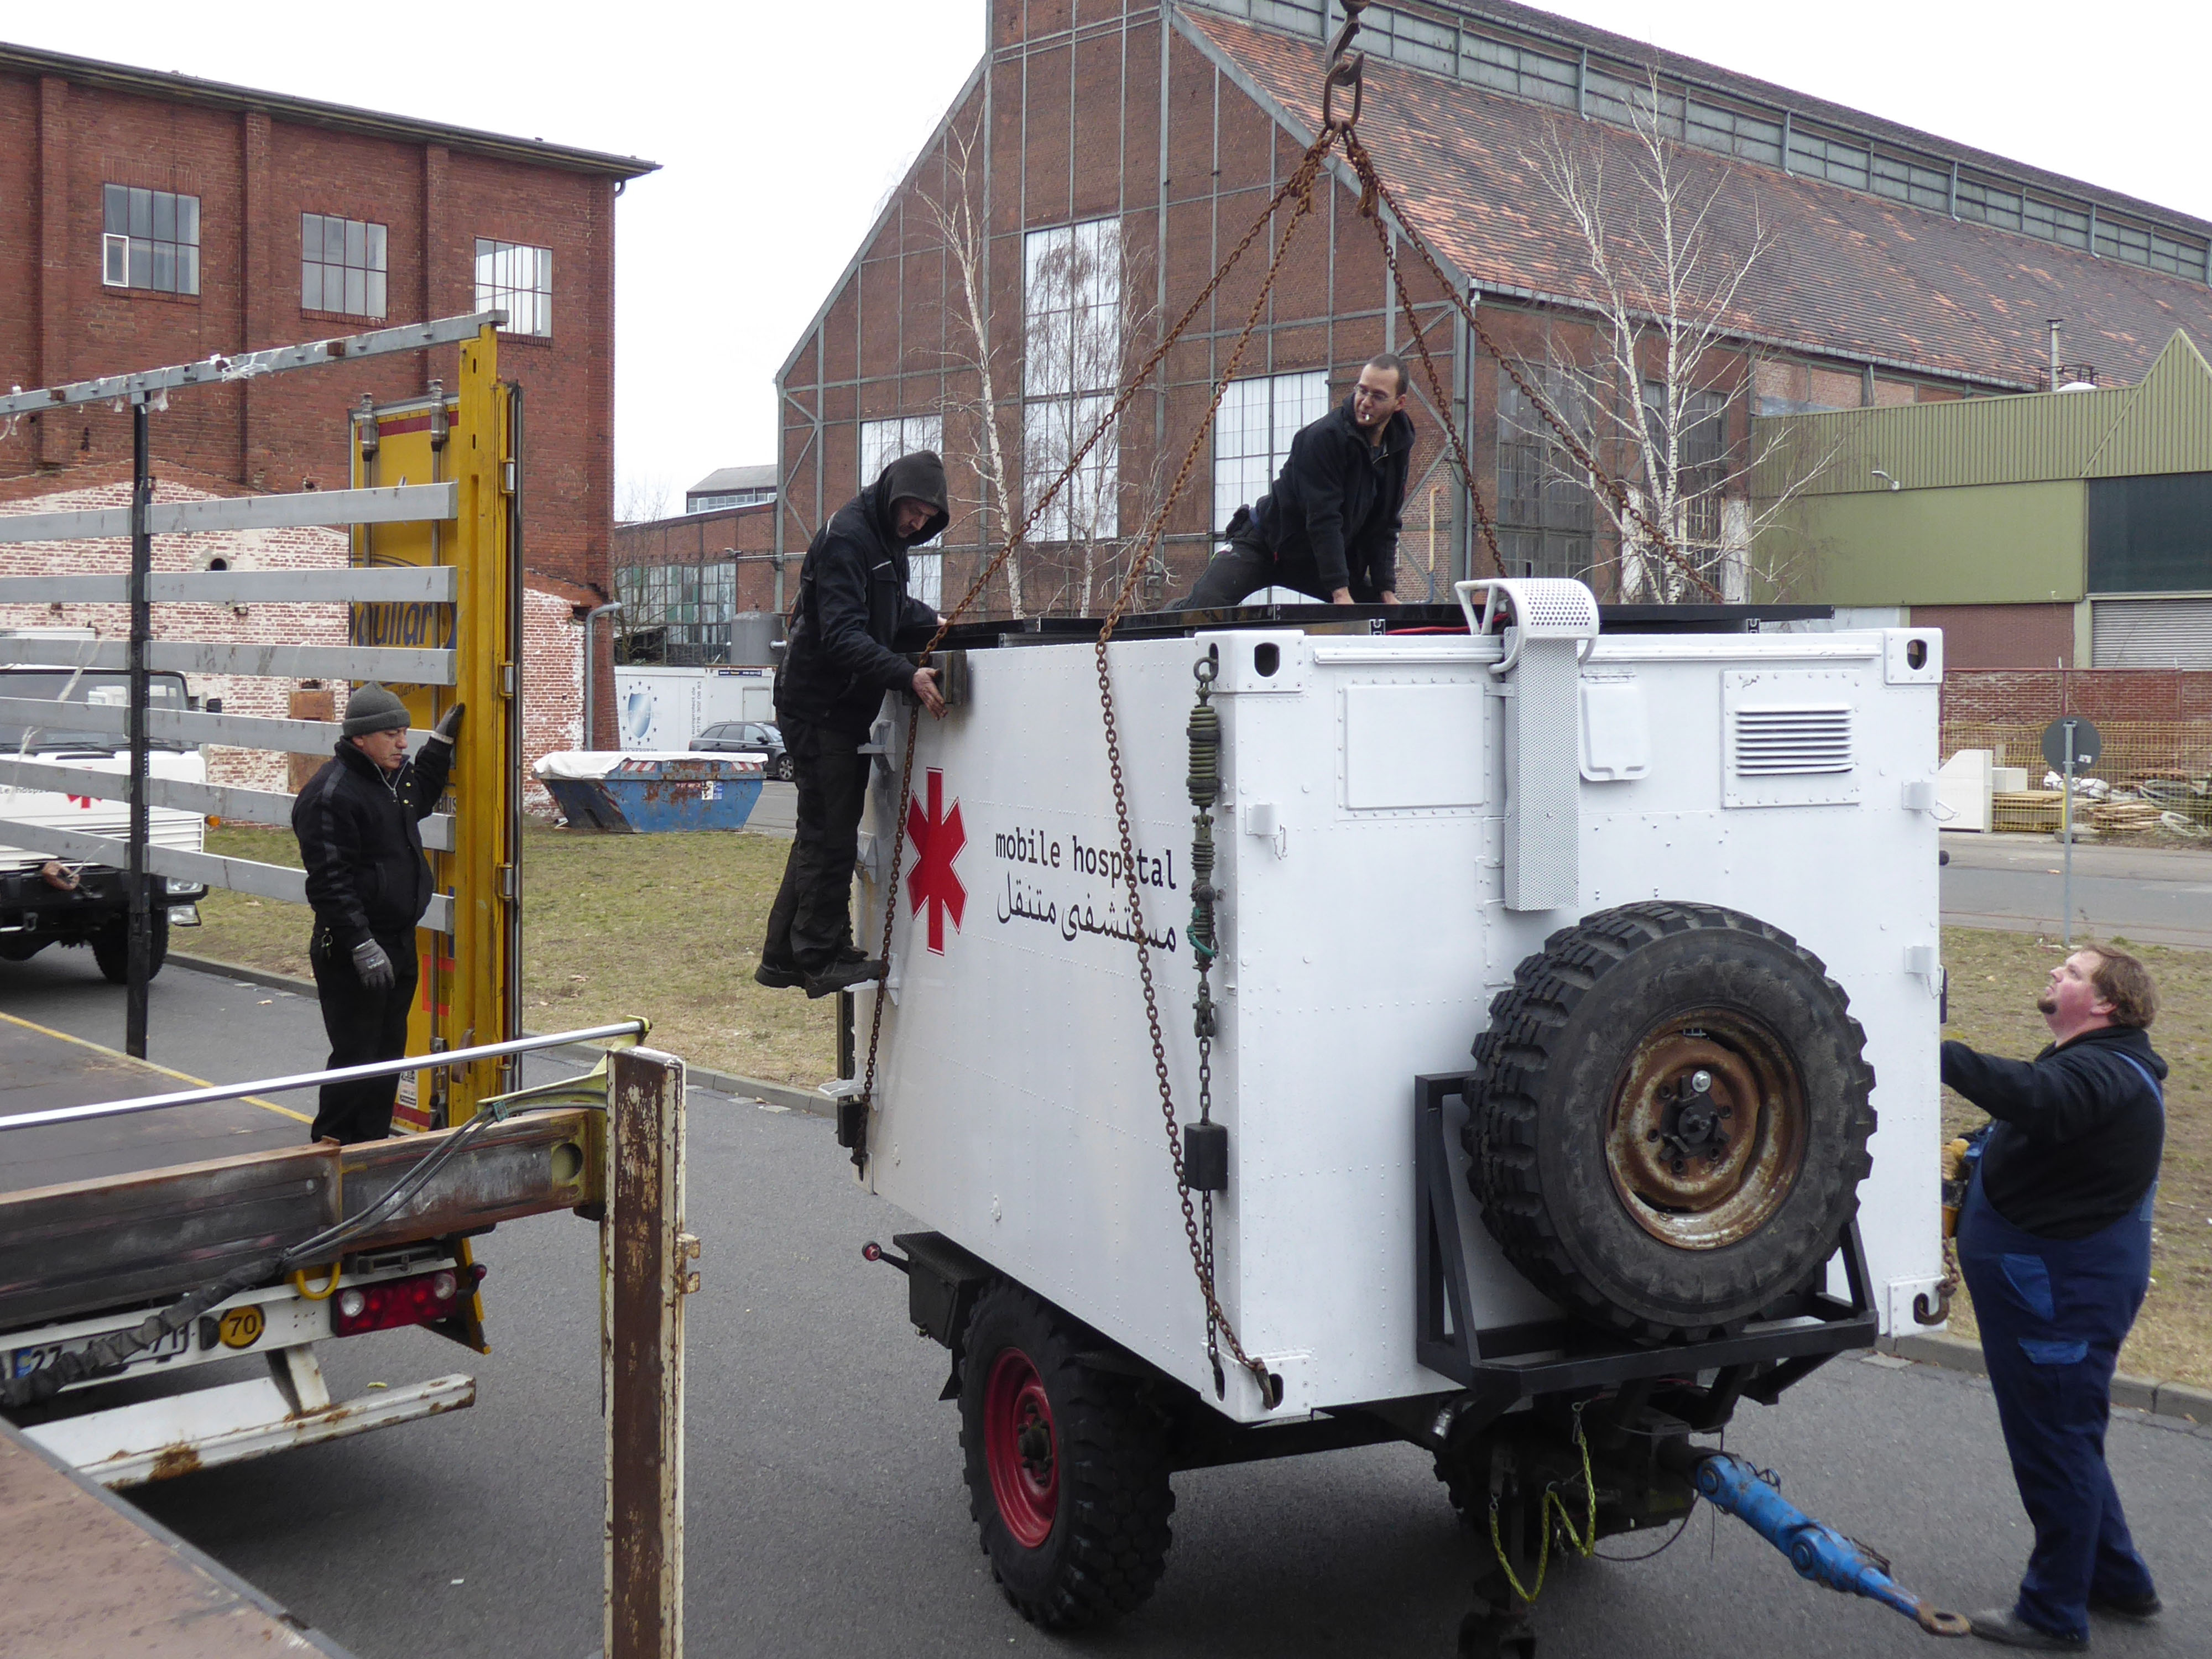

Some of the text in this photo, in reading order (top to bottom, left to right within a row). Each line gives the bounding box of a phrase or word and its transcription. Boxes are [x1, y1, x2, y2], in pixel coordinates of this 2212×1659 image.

[995, 827, 1060, 868] mobile
[997, 870, 1056, 925] متنقل
[229, 1314, 258, 1337] 70
